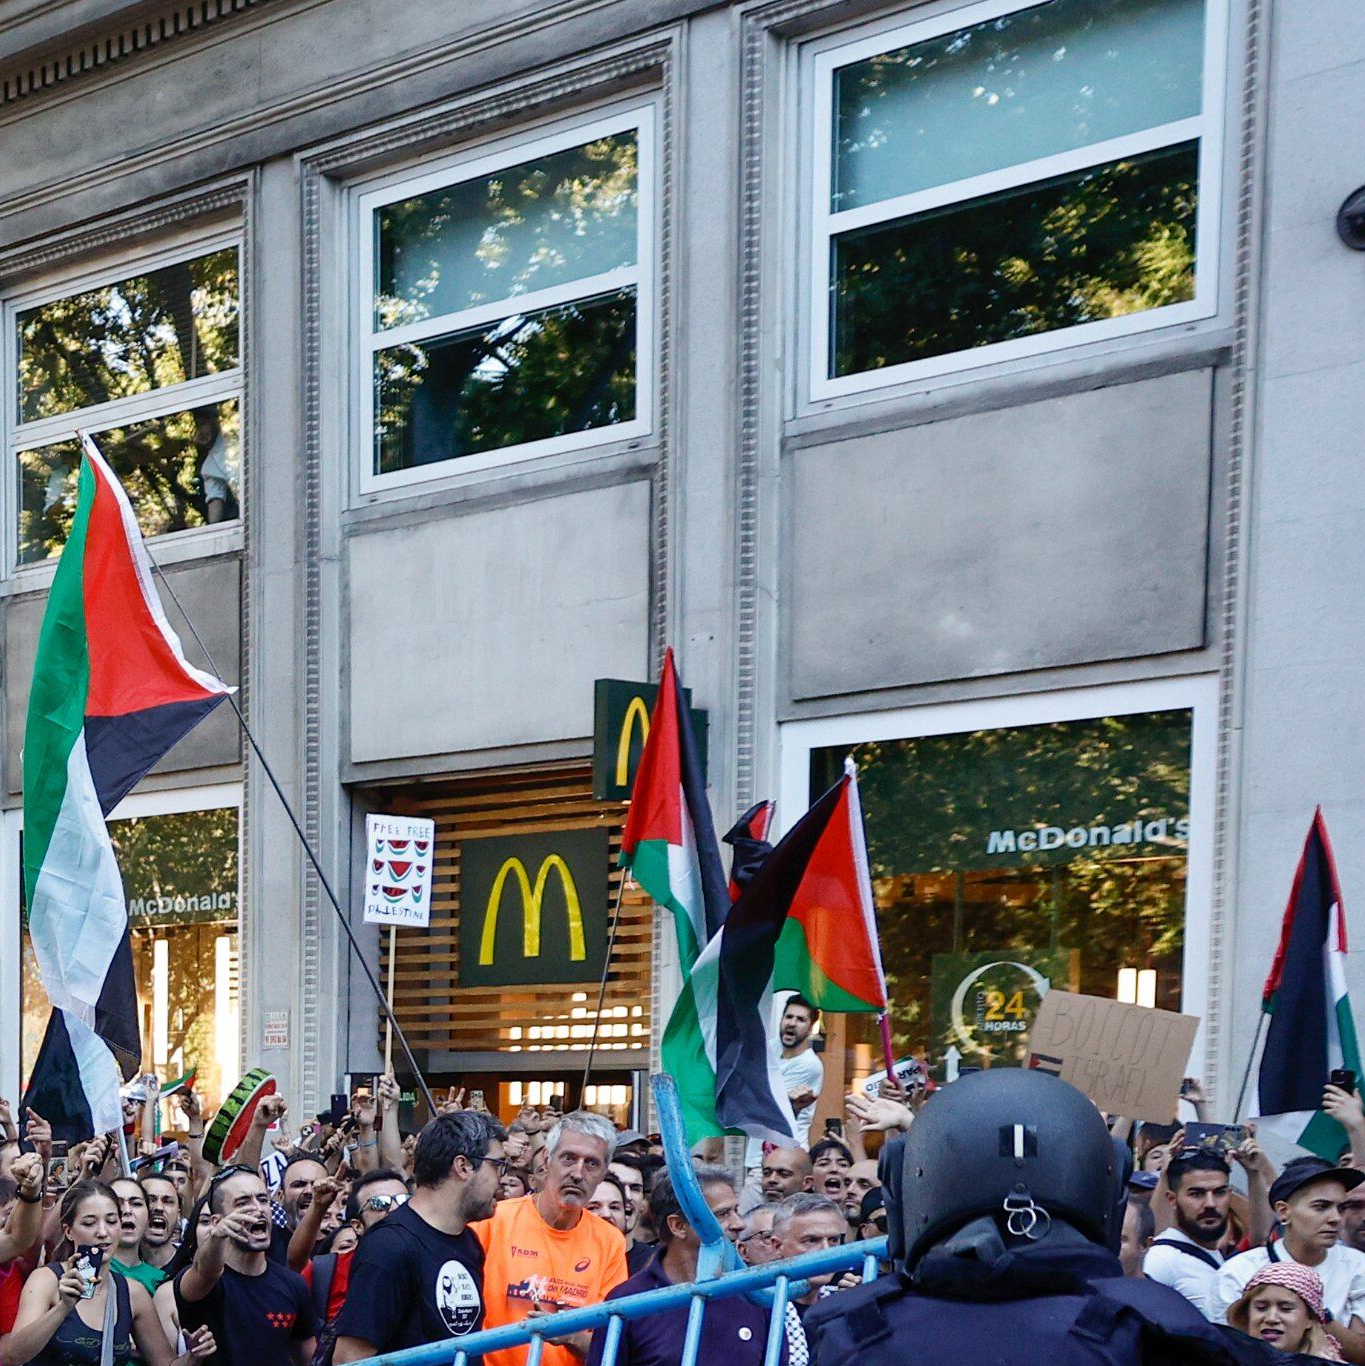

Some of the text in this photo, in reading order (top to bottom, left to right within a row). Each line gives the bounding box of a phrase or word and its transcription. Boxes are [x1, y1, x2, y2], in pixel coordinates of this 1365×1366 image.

[374, 823, 430, 839] FREE FREE
[986, 817, 1190, 854] McDonald's
[369, 904, 424, 920] PALESTINE
[985, 991, 1027, 1020] 24
[985, 1021, 1027, 1031] HORAS
[1049, 999, 1183, 1068] BOICOT
[1070, 1055, 1147, 1107] ISRAEL
